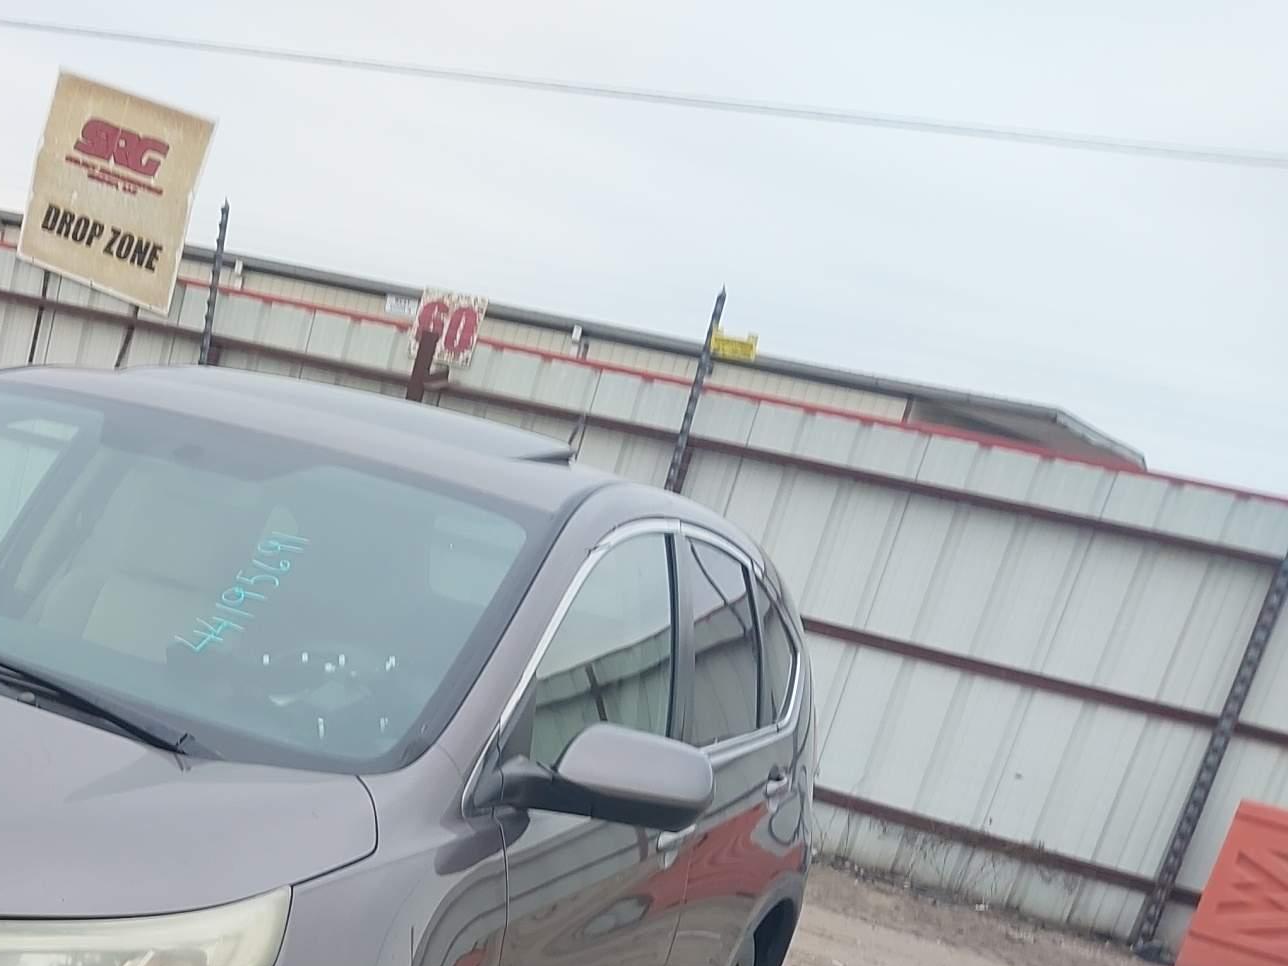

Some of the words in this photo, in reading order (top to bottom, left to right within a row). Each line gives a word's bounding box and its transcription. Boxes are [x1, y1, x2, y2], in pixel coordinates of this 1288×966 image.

[41, 204, 105, 248] DROP
[103, 225, 163, 272] ZONE
[174, 531, 310, 652] 44195691
